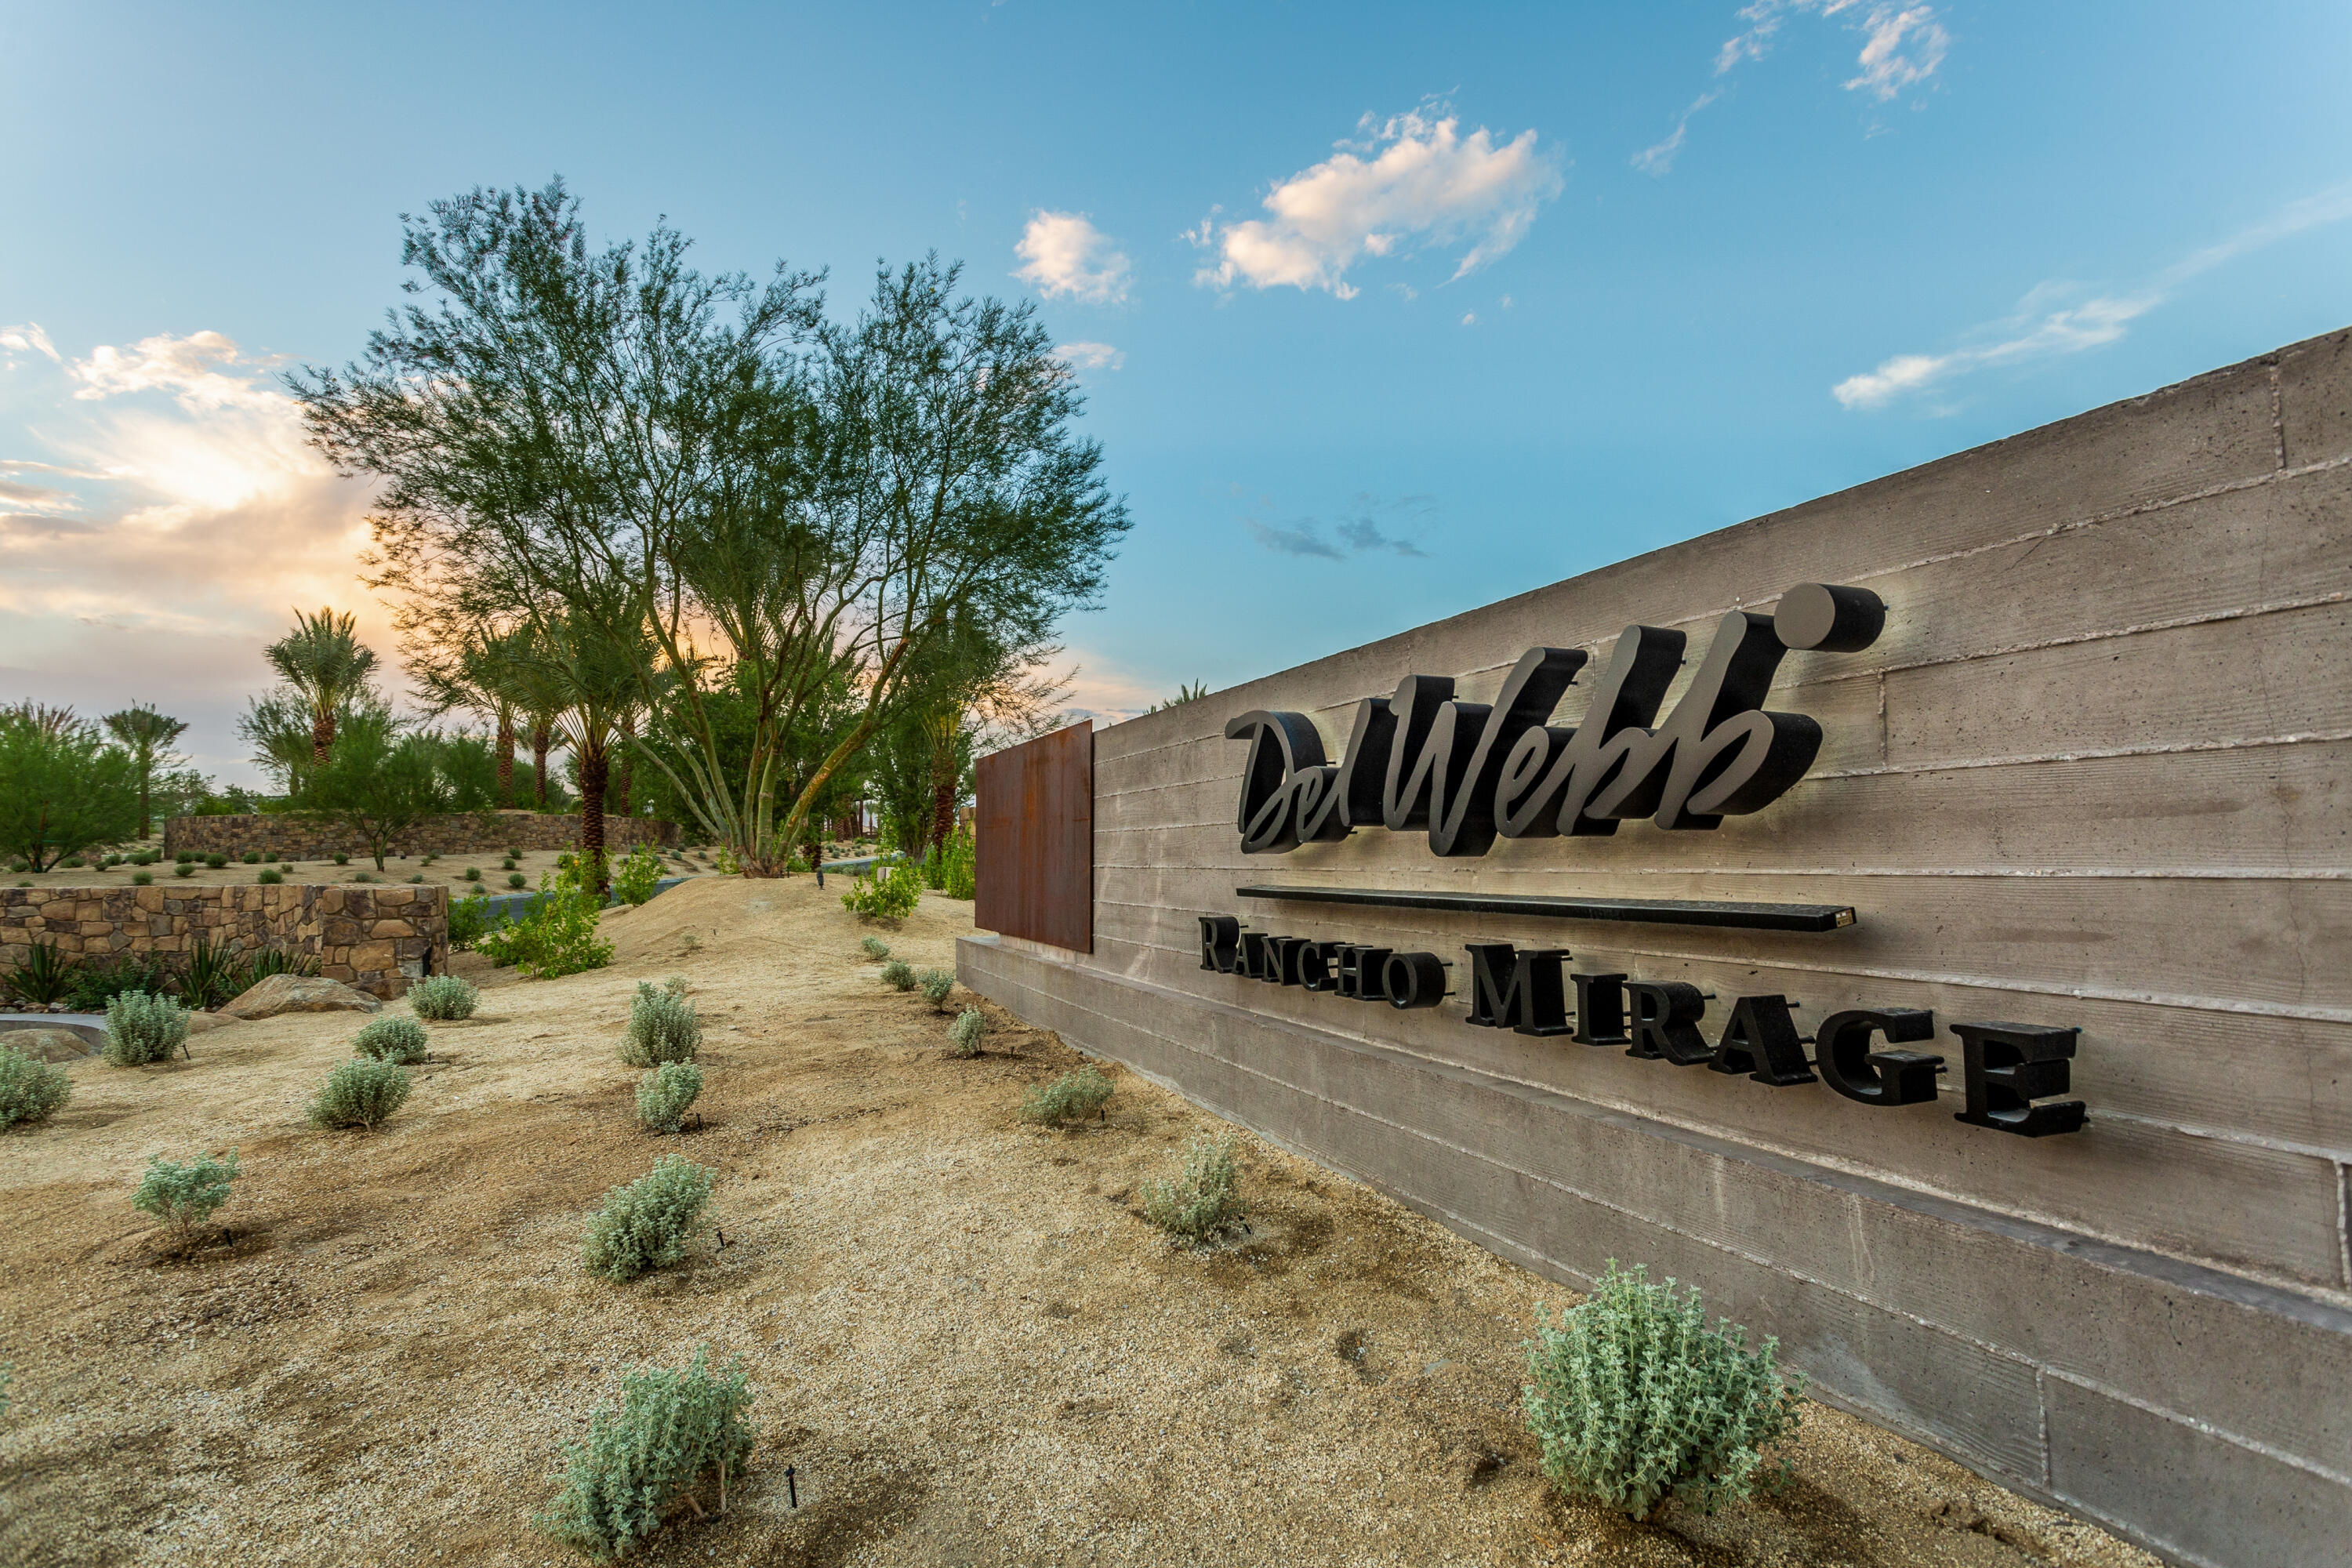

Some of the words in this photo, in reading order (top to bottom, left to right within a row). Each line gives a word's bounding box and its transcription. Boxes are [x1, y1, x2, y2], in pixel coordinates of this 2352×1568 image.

[1225, 697, 1388, 855] Del
[1384, 611, 1823, 857] Webb
[1198, 916, 1445, 1009] RANCHO
[1465, 943, 2087, 1138] MIRAGE
